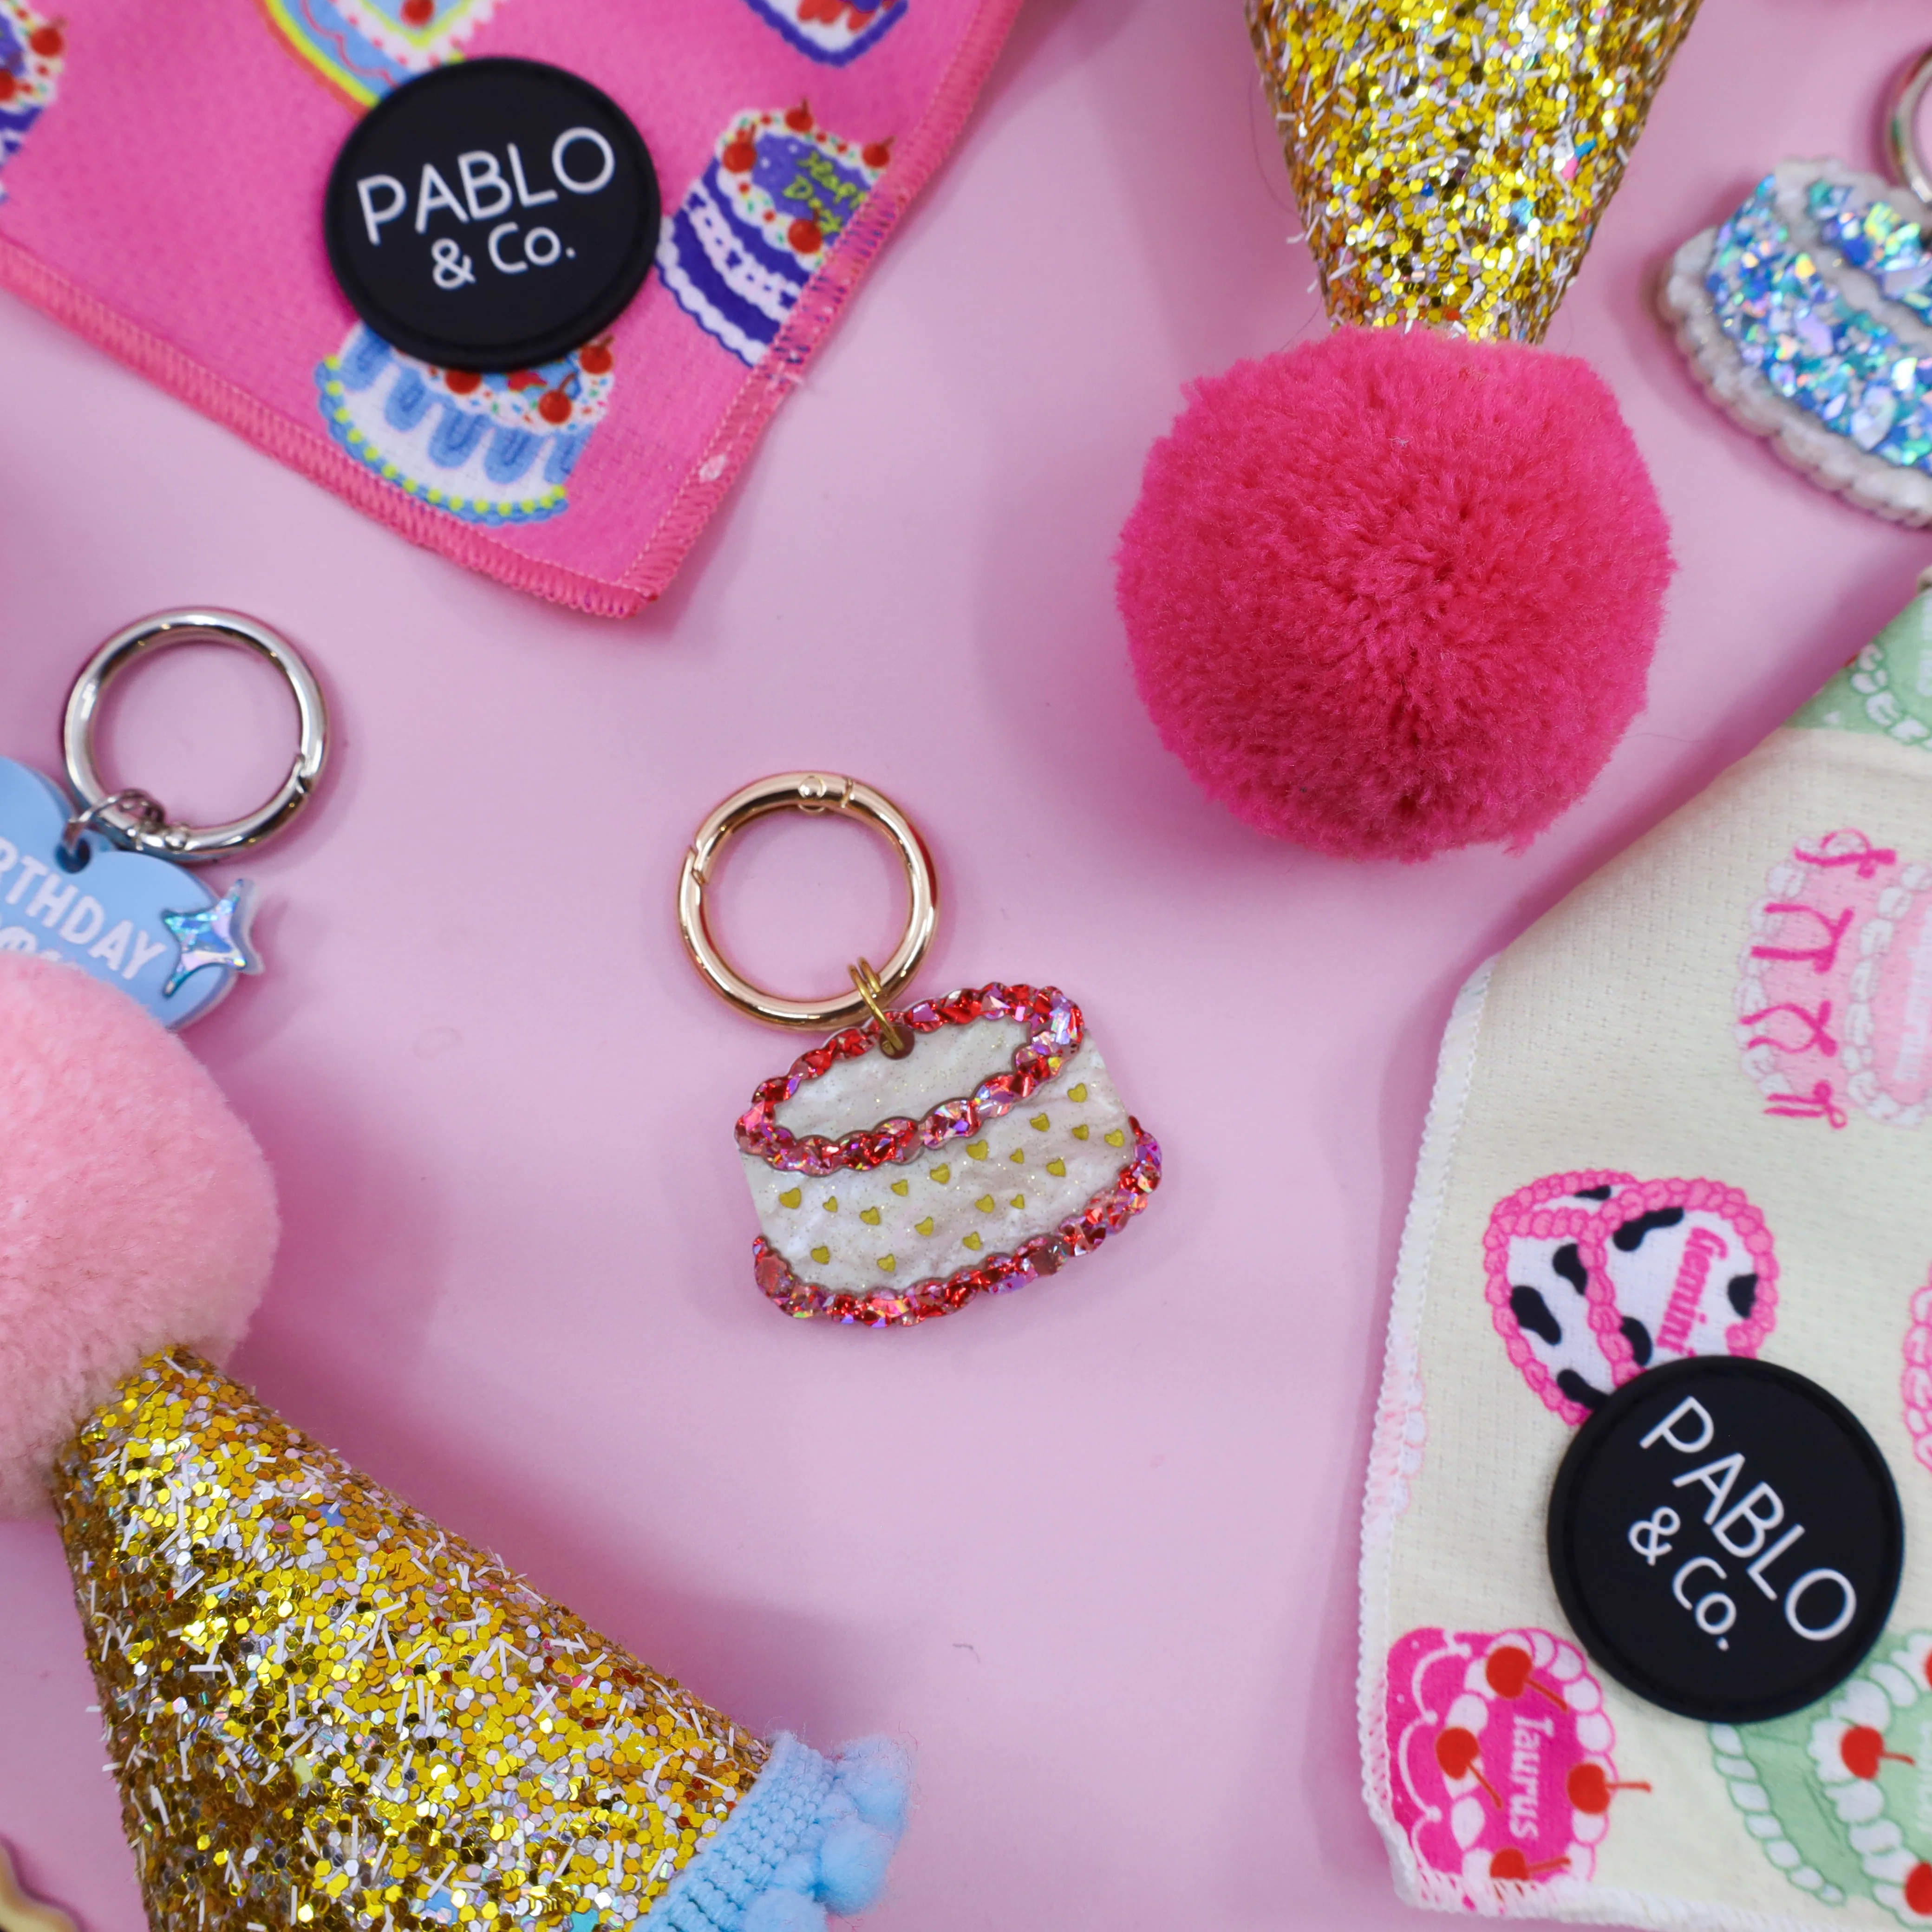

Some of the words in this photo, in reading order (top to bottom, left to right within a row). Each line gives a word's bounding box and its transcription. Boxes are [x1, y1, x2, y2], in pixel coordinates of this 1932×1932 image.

[357, 126, 615, 246] PABLO
[431, 237, 476, 290] &
[488, 221, 576, 274] Co.
[1656, 1226, 1728, 1357] Gemini
[1627, 1505, 1681, 1566] &
[1672, 1556, 1737, 1651] Co.
[1639, 1395, 1857, 1641] PABLO
[1508, 1713, 1555, 1839] Taurus
